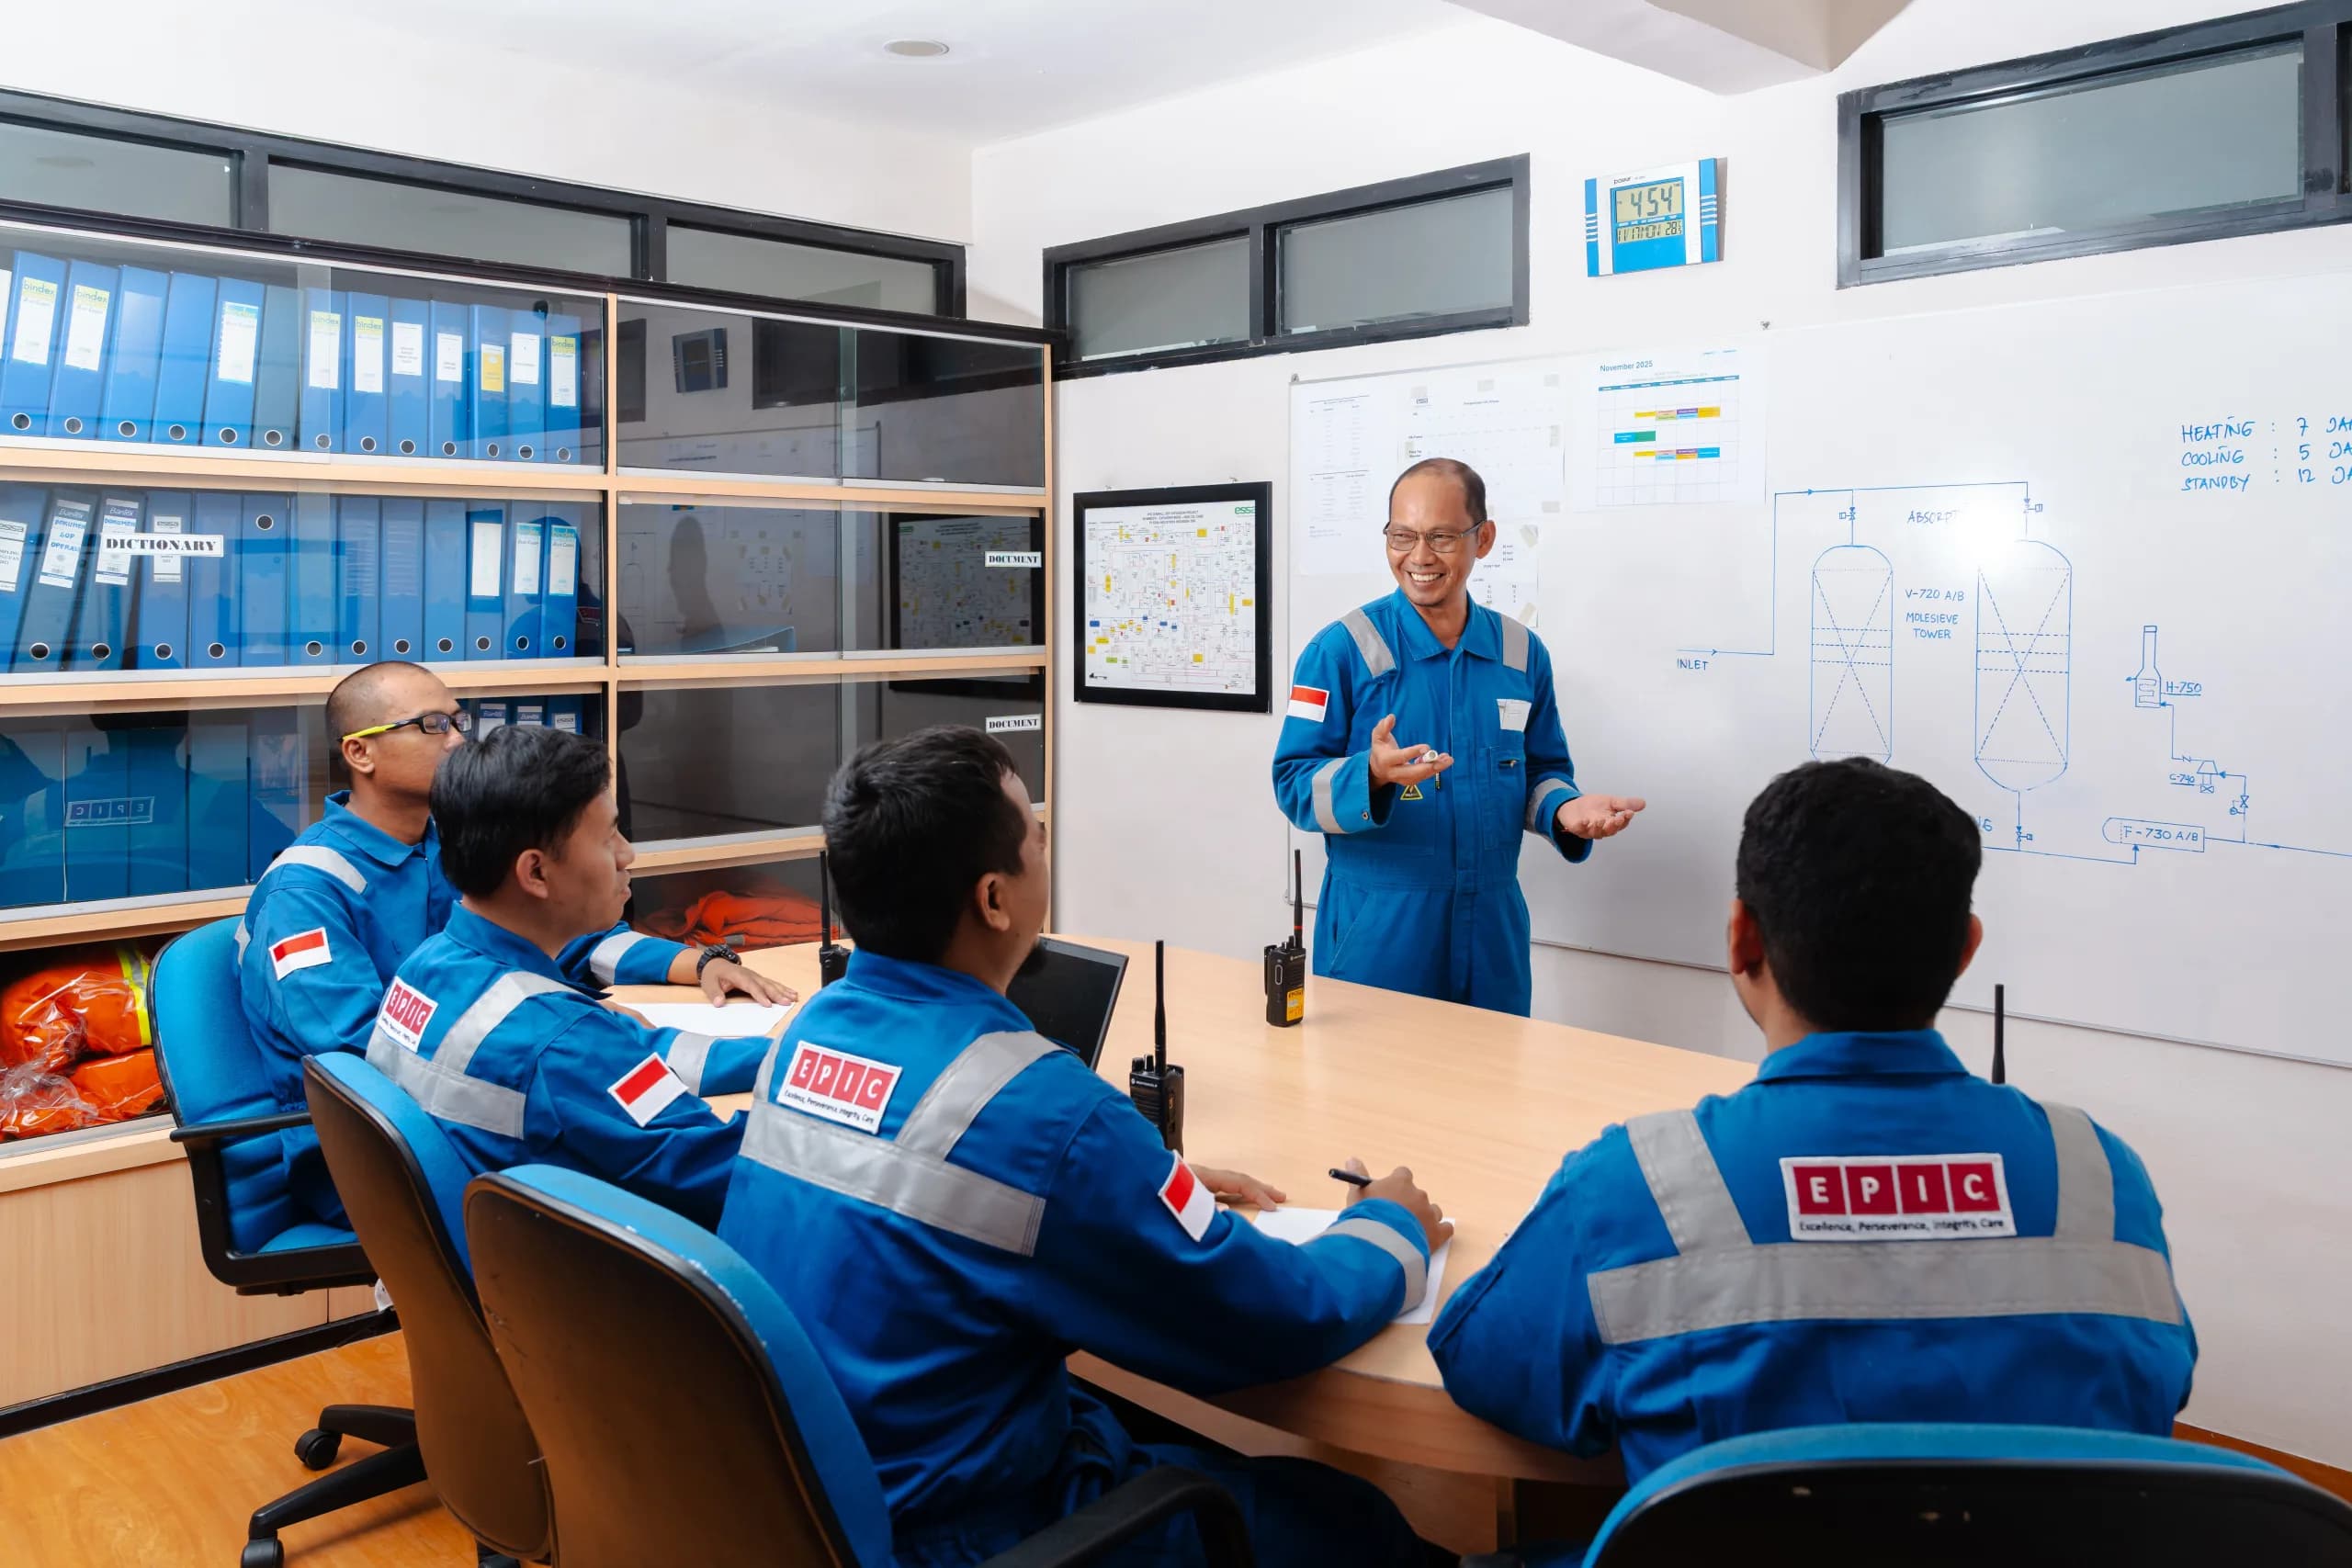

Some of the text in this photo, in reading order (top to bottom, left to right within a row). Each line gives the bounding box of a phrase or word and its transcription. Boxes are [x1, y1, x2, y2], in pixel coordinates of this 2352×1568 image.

[1600, 360, 1654, 372] November 2025
[2181, 416, 2256, 443] HEATING
[2297, 417, 2309, 436] 7
[2181, 446, 2245, 467] COOLING
[2299, 444, 2312, 460] 5
[2181, 473, 2251, 492] STANDBY
[2298, 468, 2316, 483] 12
[106, 538, 217, 552] DICTIONARY
[989, 555, 1039, 564] DOCUMENT
[1905, 589, 1964, 602] V-720 A/B
[1905, 612, 1959, 625] MOLESIEVE
[1913, 627, 1951, 639] TOWER
[1677, 658, 1710, 671] INLET
[2165, 681, 2202, 694] H-750
[989, 718, 1039, 729] DOCUMENT
[2169, 773, 2195, 784] C-740
[2175, 830, 2199, 841] A/B
[390, 990, 427, 1026] EPIC
[798, 1057, 883, 1100] EPIC
[1808, 1173, 1985, 1204] EPIC
[1798, 1217, 2005, 1233] Excellence, Perseverance, Integrity, Care
